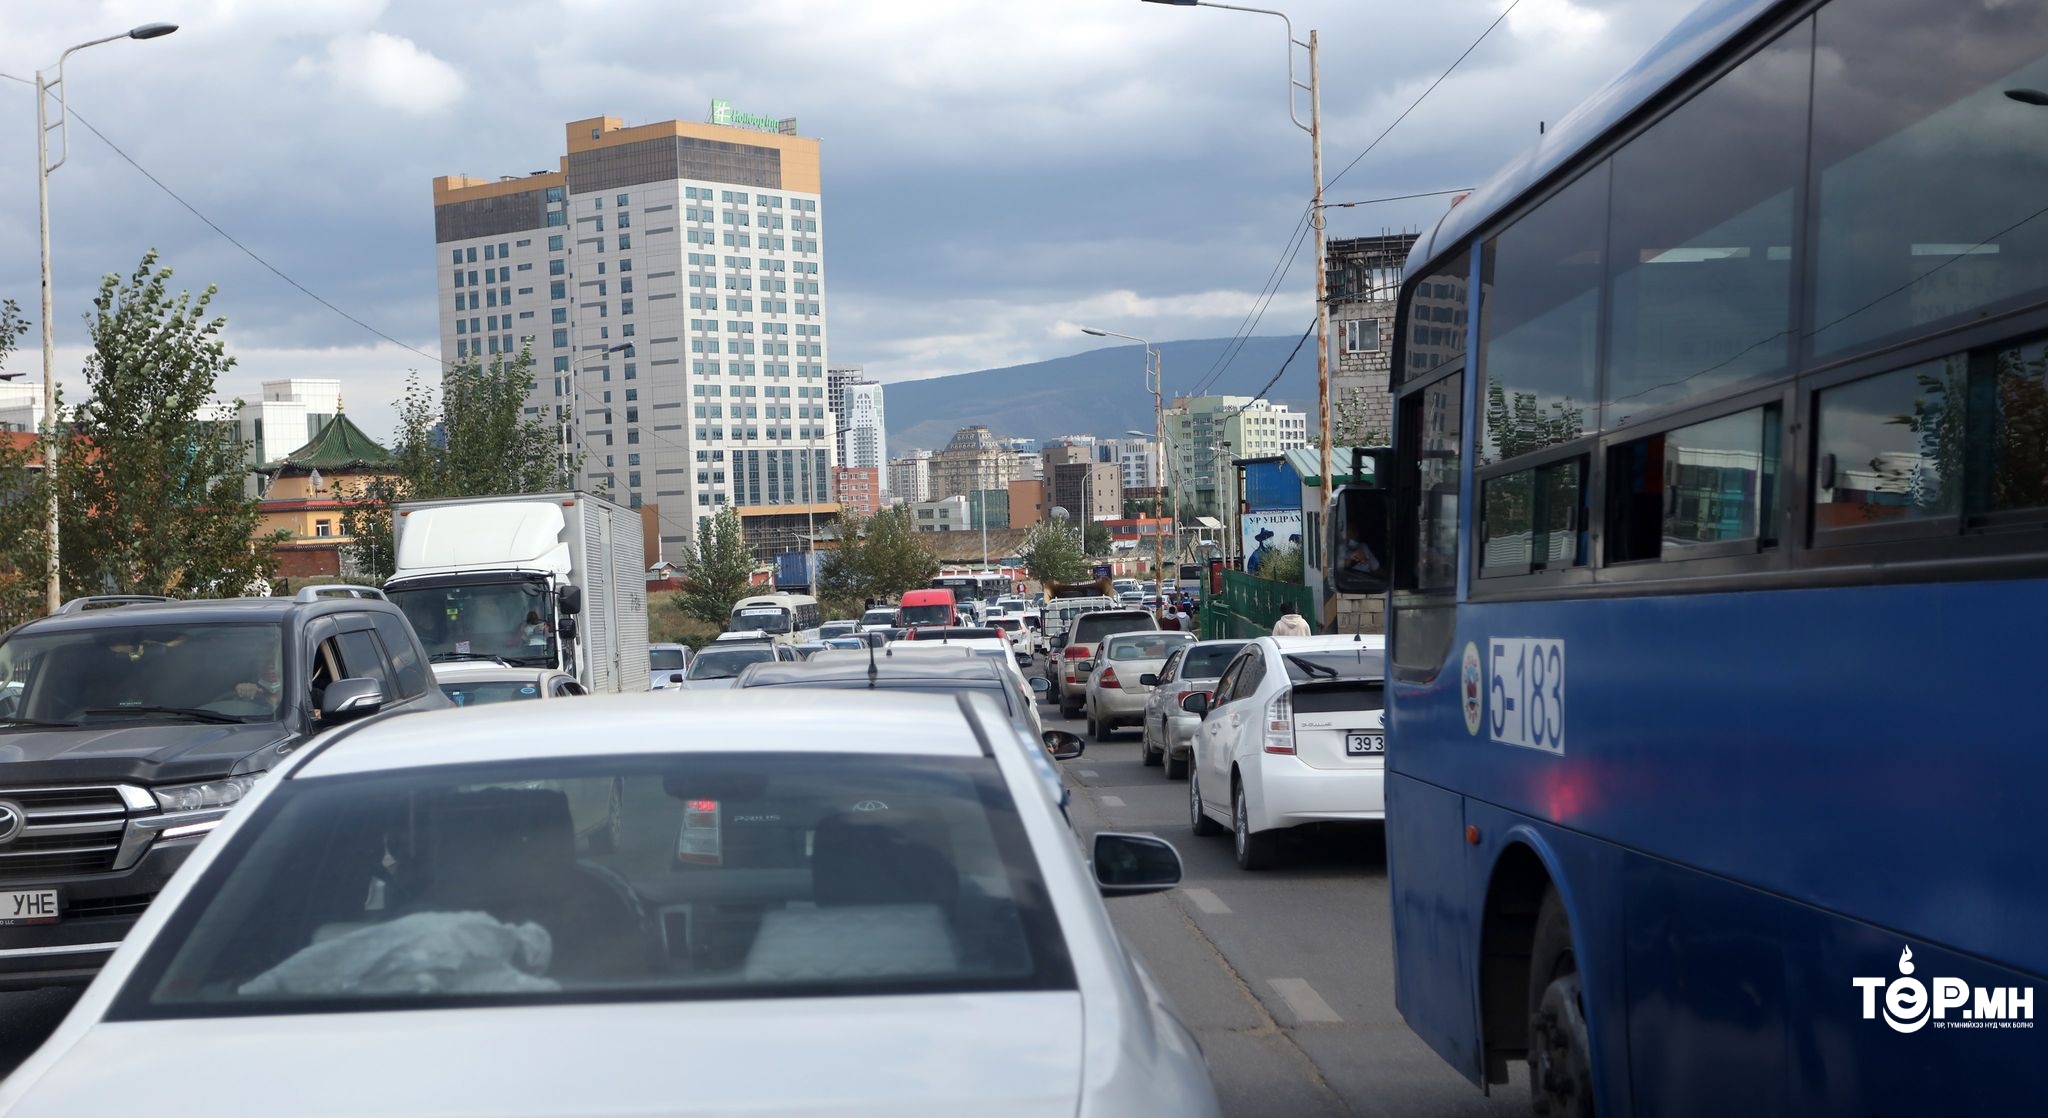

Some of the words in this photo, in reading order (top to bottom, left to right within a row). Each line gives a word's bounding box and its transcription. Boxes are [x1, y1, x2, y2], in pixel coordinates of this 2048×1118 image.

[1492, 643, 1562, 749] 5-183
[1355, 736, 1371, 750] 39
[13, 893, 55, 916] УНЕ
